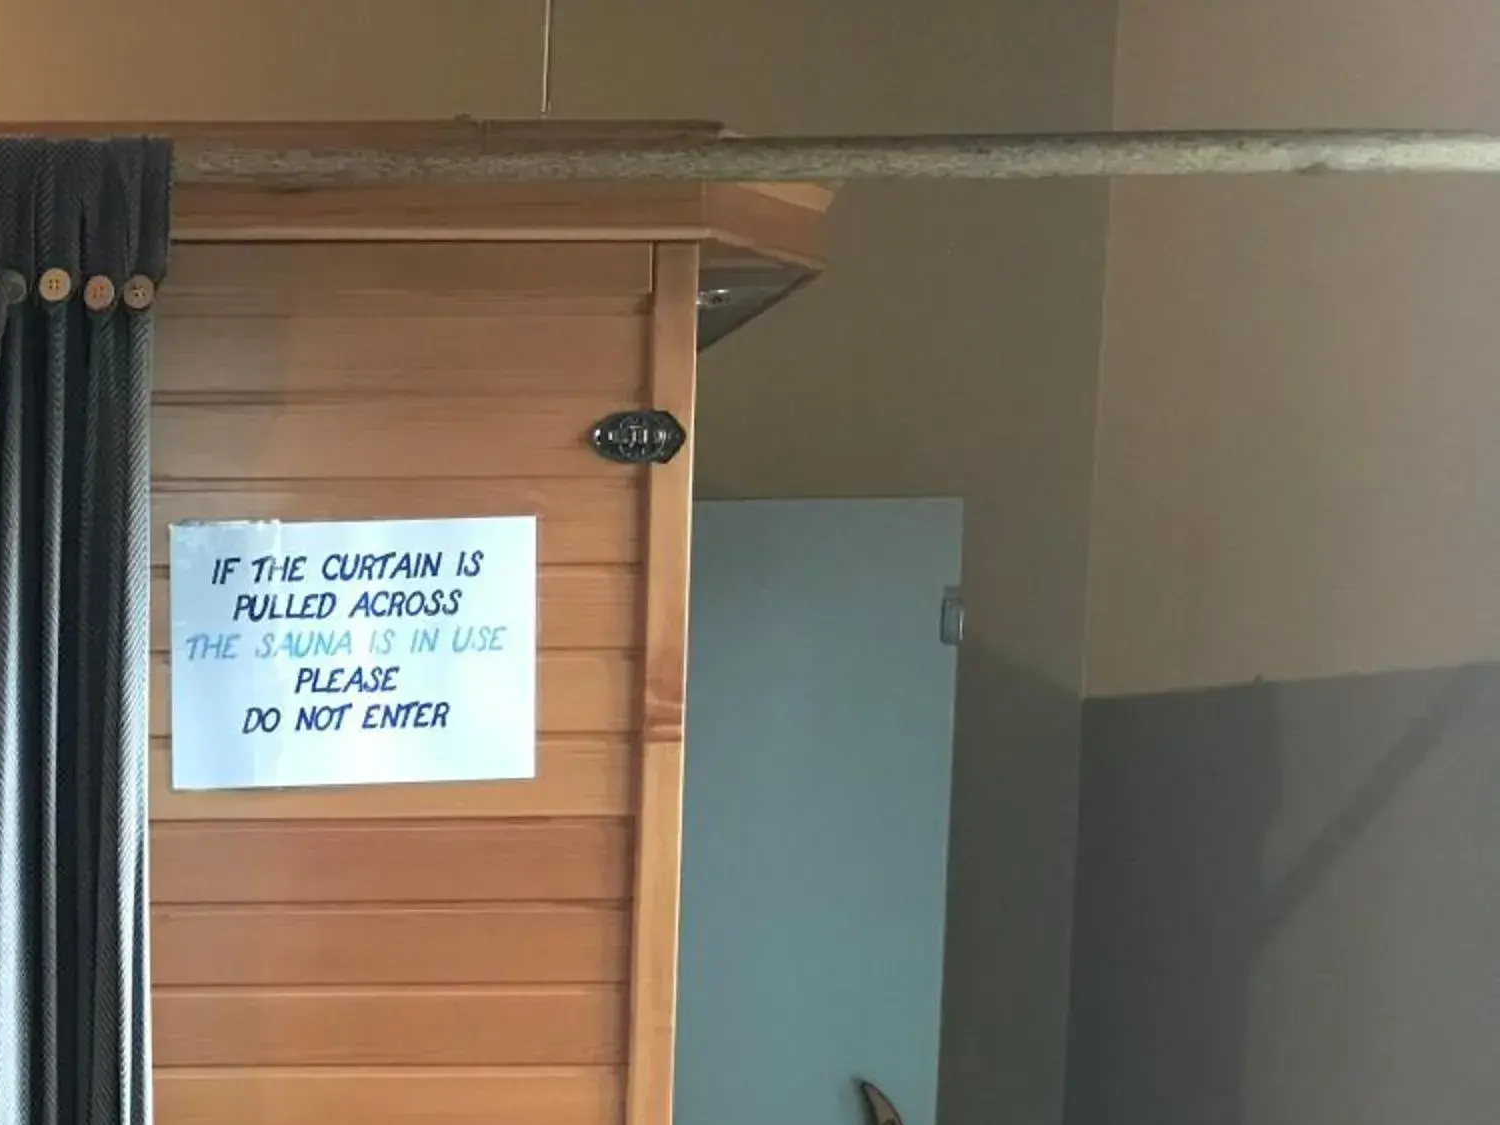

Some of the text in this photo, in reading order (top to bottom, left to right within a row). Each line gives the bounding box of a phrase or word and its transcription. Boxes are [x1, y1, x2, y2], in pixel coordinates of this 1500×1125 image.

[211, 550, 484, 585] IF THE CURTAIN IS
[233, 590, 463, 622] PULLED ACROSS
[186, 626, 508, 661] THE SAUNA IS IN USE
[294, 666, 400, 694] PLEASE
[242, 701, 450, 734] DO NOT ENTER
